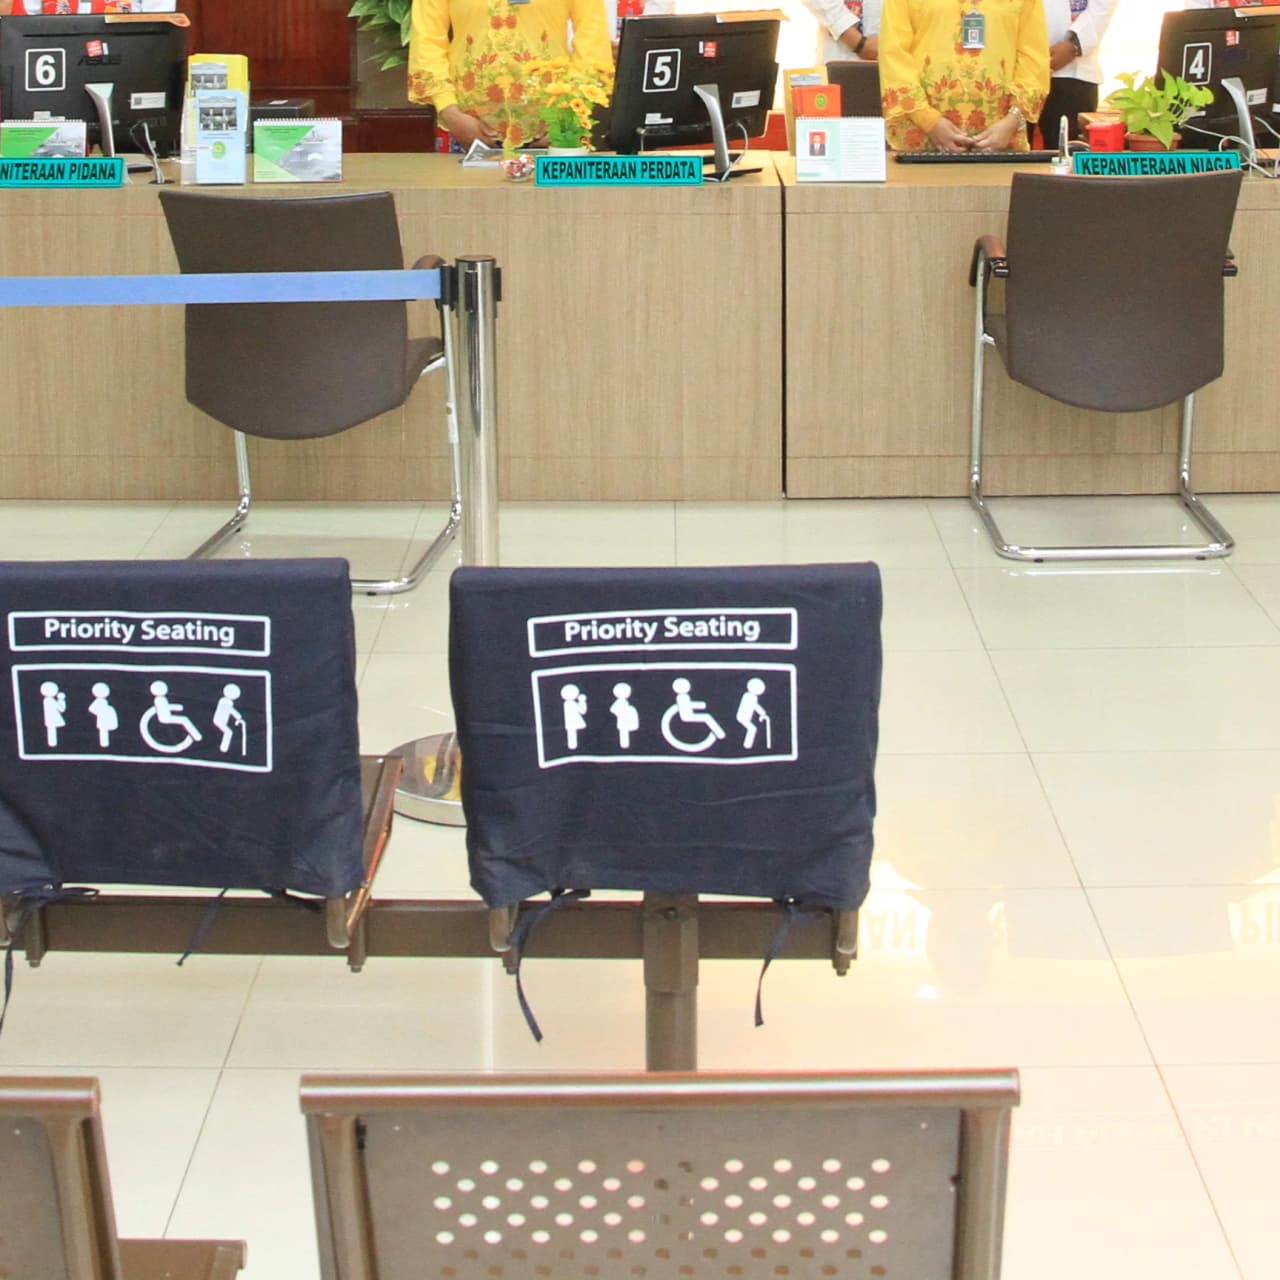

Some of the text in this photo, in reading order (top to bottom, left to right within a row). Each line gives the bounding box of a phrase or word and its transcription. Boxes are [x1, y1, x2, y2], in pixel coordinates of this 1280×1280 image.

[35, 54, 56, 85] 6
[652, 56, 671, 86] 5
[1189, 49, 1205, 79] 4
[69, 162, 116, 180] PIDANA
[543, 160, 695, 179] KEPANITERAAN PERDATA
[1081, 157, 1232, 175] KEPANITERAAN NIAGA
[44, 618, 235, 647] Priority Seating
[564, 615, 761, 643] Priority Seating
